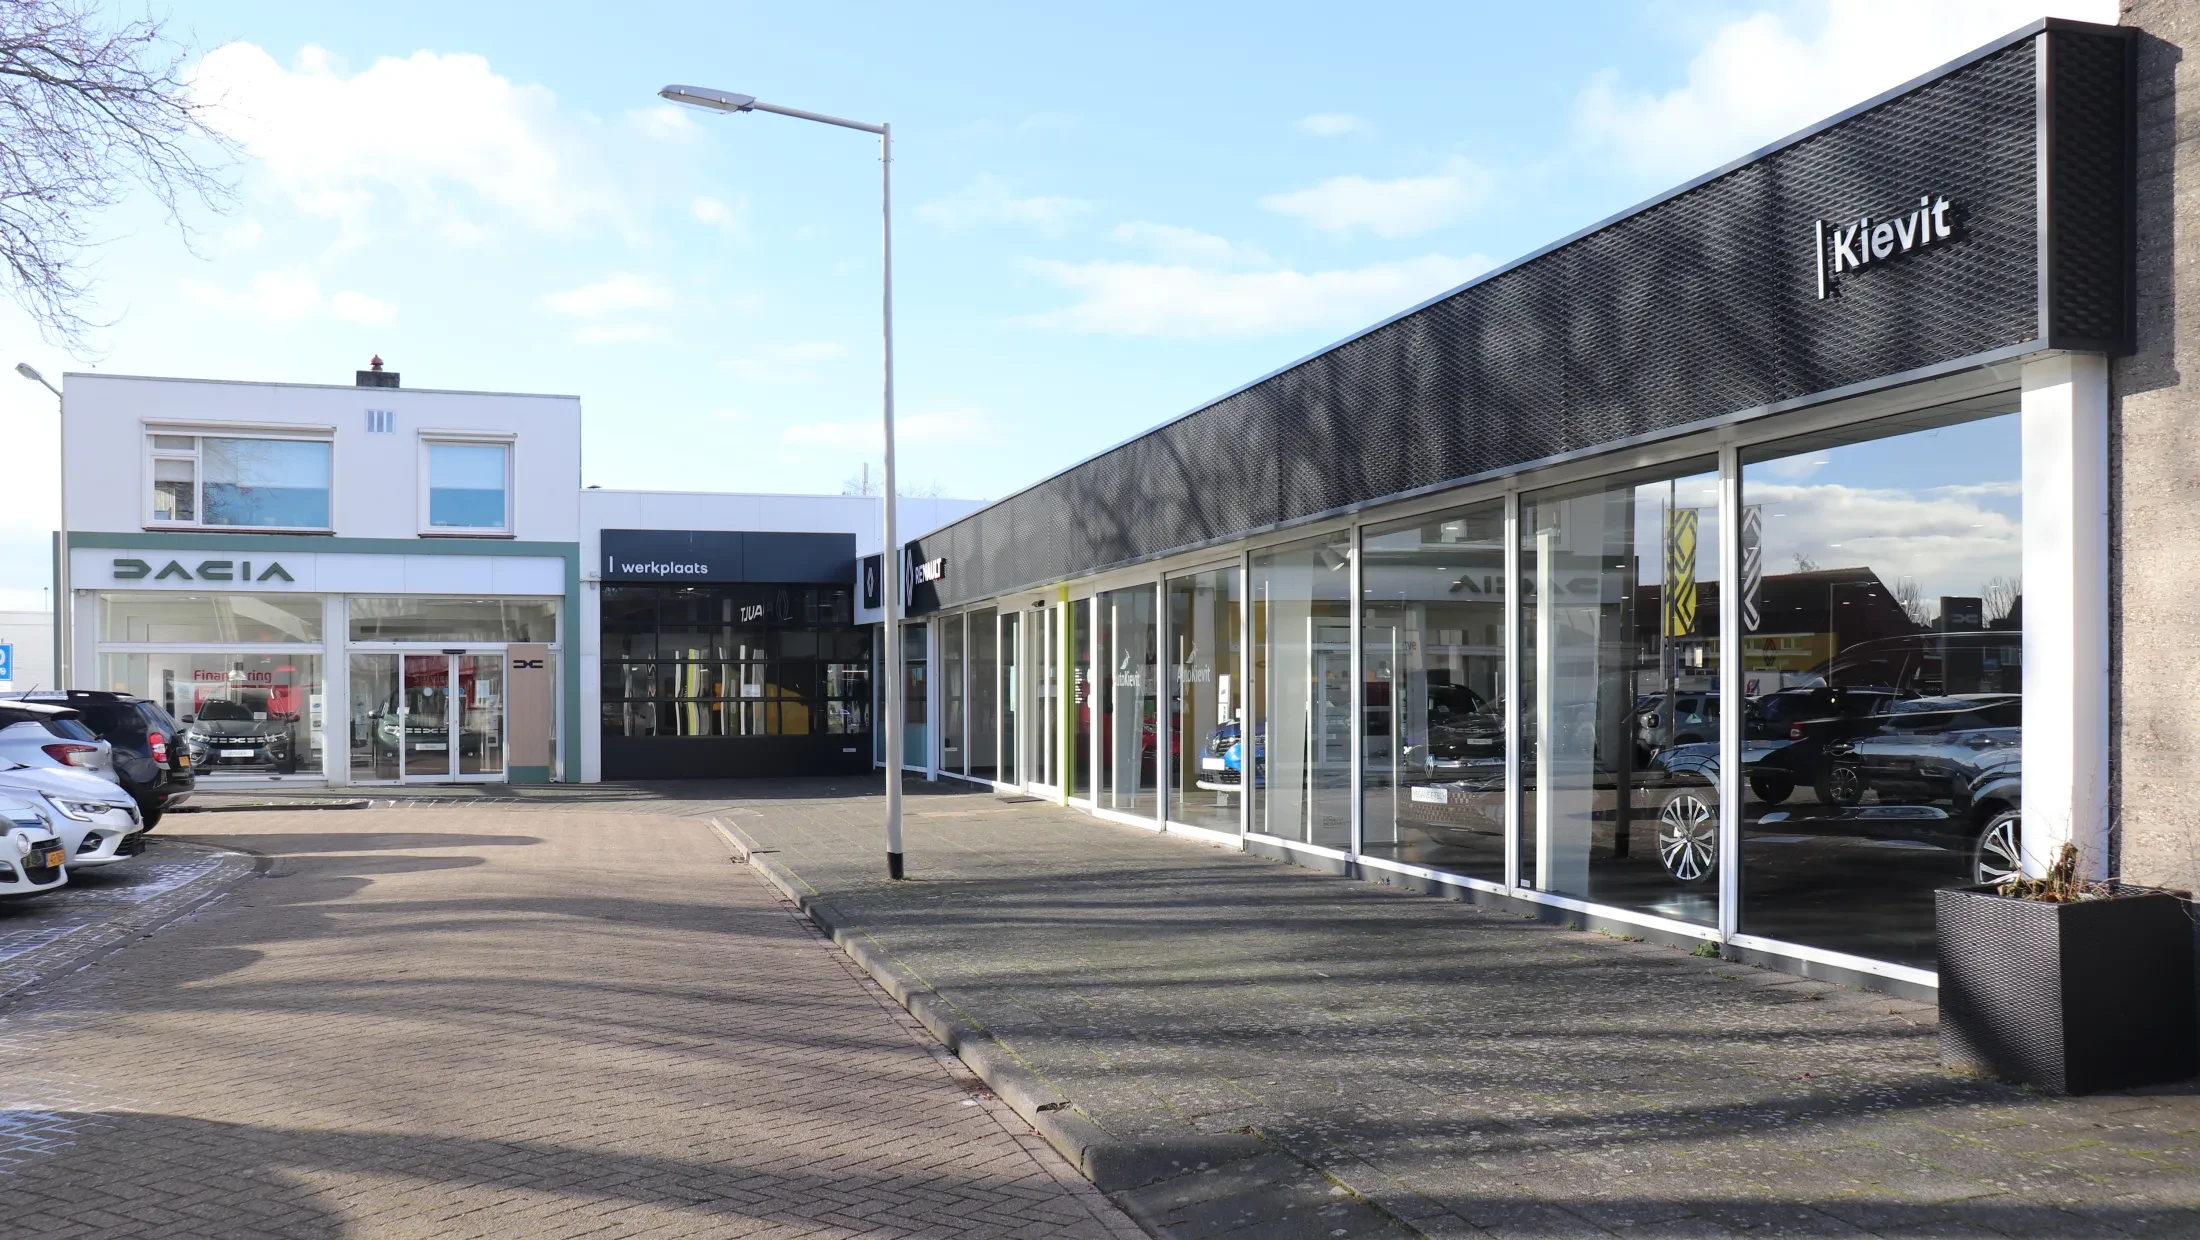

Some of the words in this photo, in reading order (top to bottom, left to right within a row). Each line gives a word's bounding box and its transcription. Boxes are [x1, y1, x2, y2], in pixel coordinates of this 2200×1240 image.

[1834, 195, 1951, 273] Kievit
[113, 558, 295, 582] DACIA
[621, 561, 708, 577] werkplaats
[915, 557, 942, 584] RENAULT
[194, 670, 272, 683] Finanring
[1114, 670, 1141, 687] utoKievit
